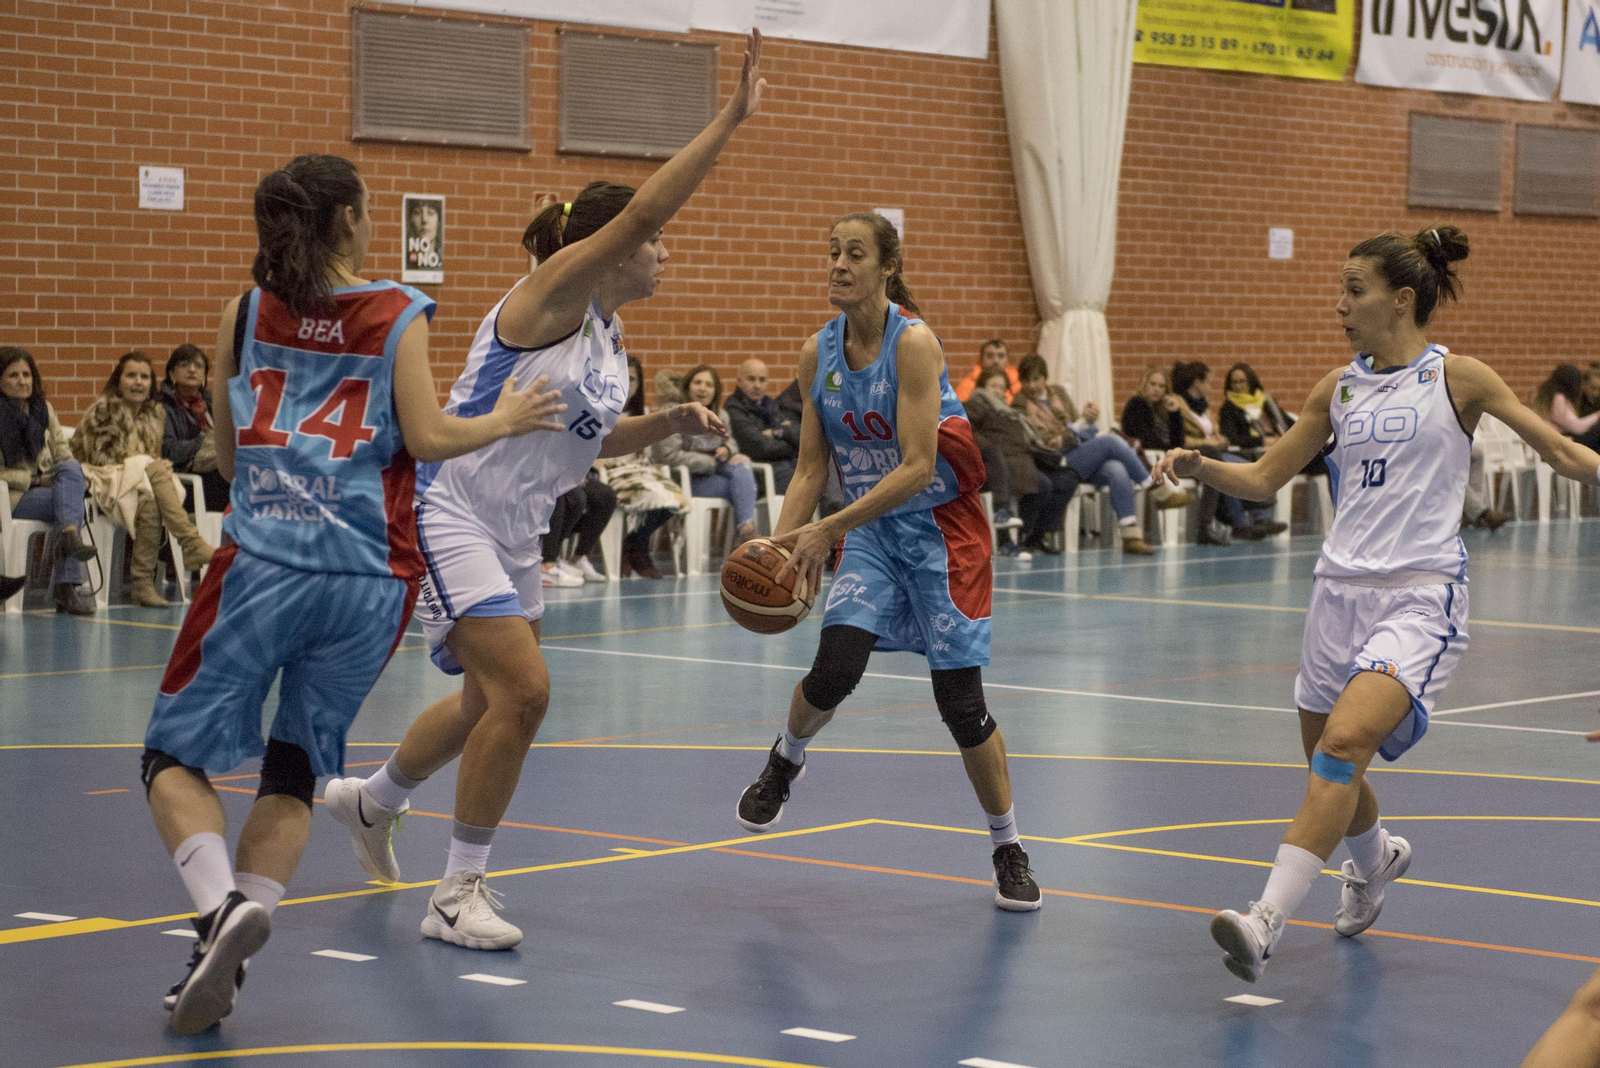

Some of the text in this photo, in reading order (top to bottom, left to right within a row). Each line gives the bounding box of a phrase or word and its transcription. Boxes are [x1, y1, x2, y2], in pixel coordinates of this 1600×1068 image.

[409, 237, 430, 253] NO
[298, 317, 345, 345] BEA
[236, 366, 377, 462] 14
[568, 409, 603, 441] 15
[841, 410, 894, 442] 10
[1361, 457, 1388, 489] 10
